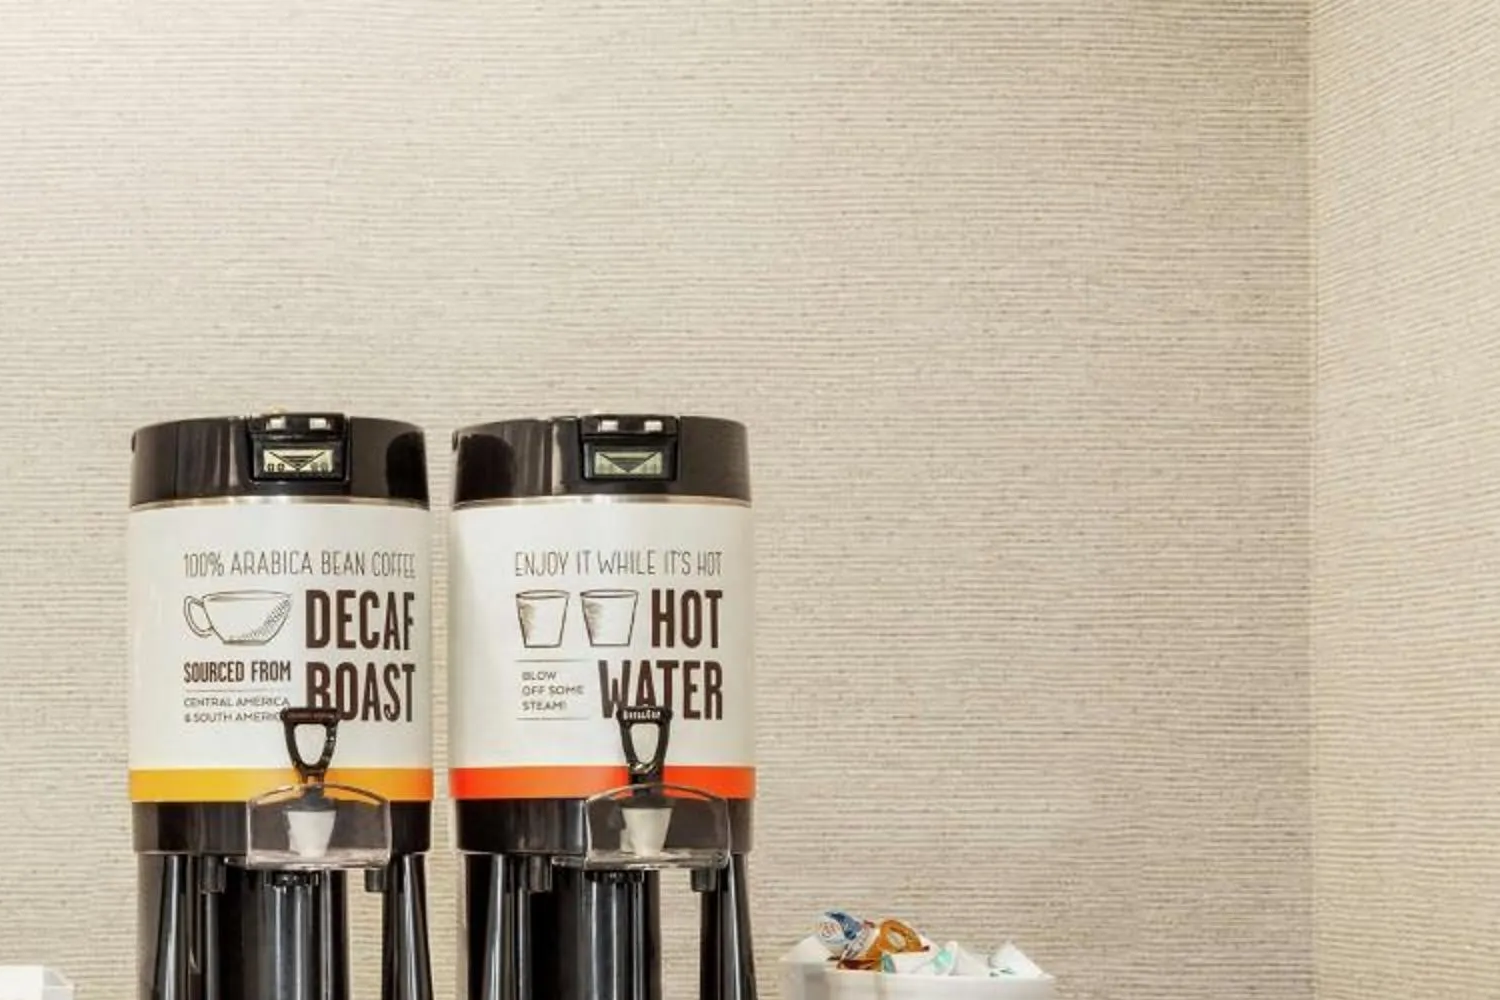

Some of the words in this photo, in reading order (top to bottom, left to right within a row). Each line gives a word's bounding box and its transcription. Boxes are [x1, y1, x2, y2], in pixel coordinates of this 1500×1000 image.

[183, 551, 225, 578] 100%
[230, 549, 314, 577] ARABICA
[320, 549, 365, 576] BEAN
[371, 551, 416, 579] COFFEE
[515, 551, 569, 577] ENJOY
[576, 549, 592, 575] IT
[597, 549, 657, 575] WHILE
[664, 550, 692, 575] IT'S
[697, 551, 723, 577] HOT
[305, 589, 415, 650] DECAF
[651, 588, 724, 649] HOT
[183, 660, 244, 683] SOURCED
[251, 660, 292, 682] FROM
[305, 661, 416, 723] ROAST
[597, 659, 724, 721] WATER
